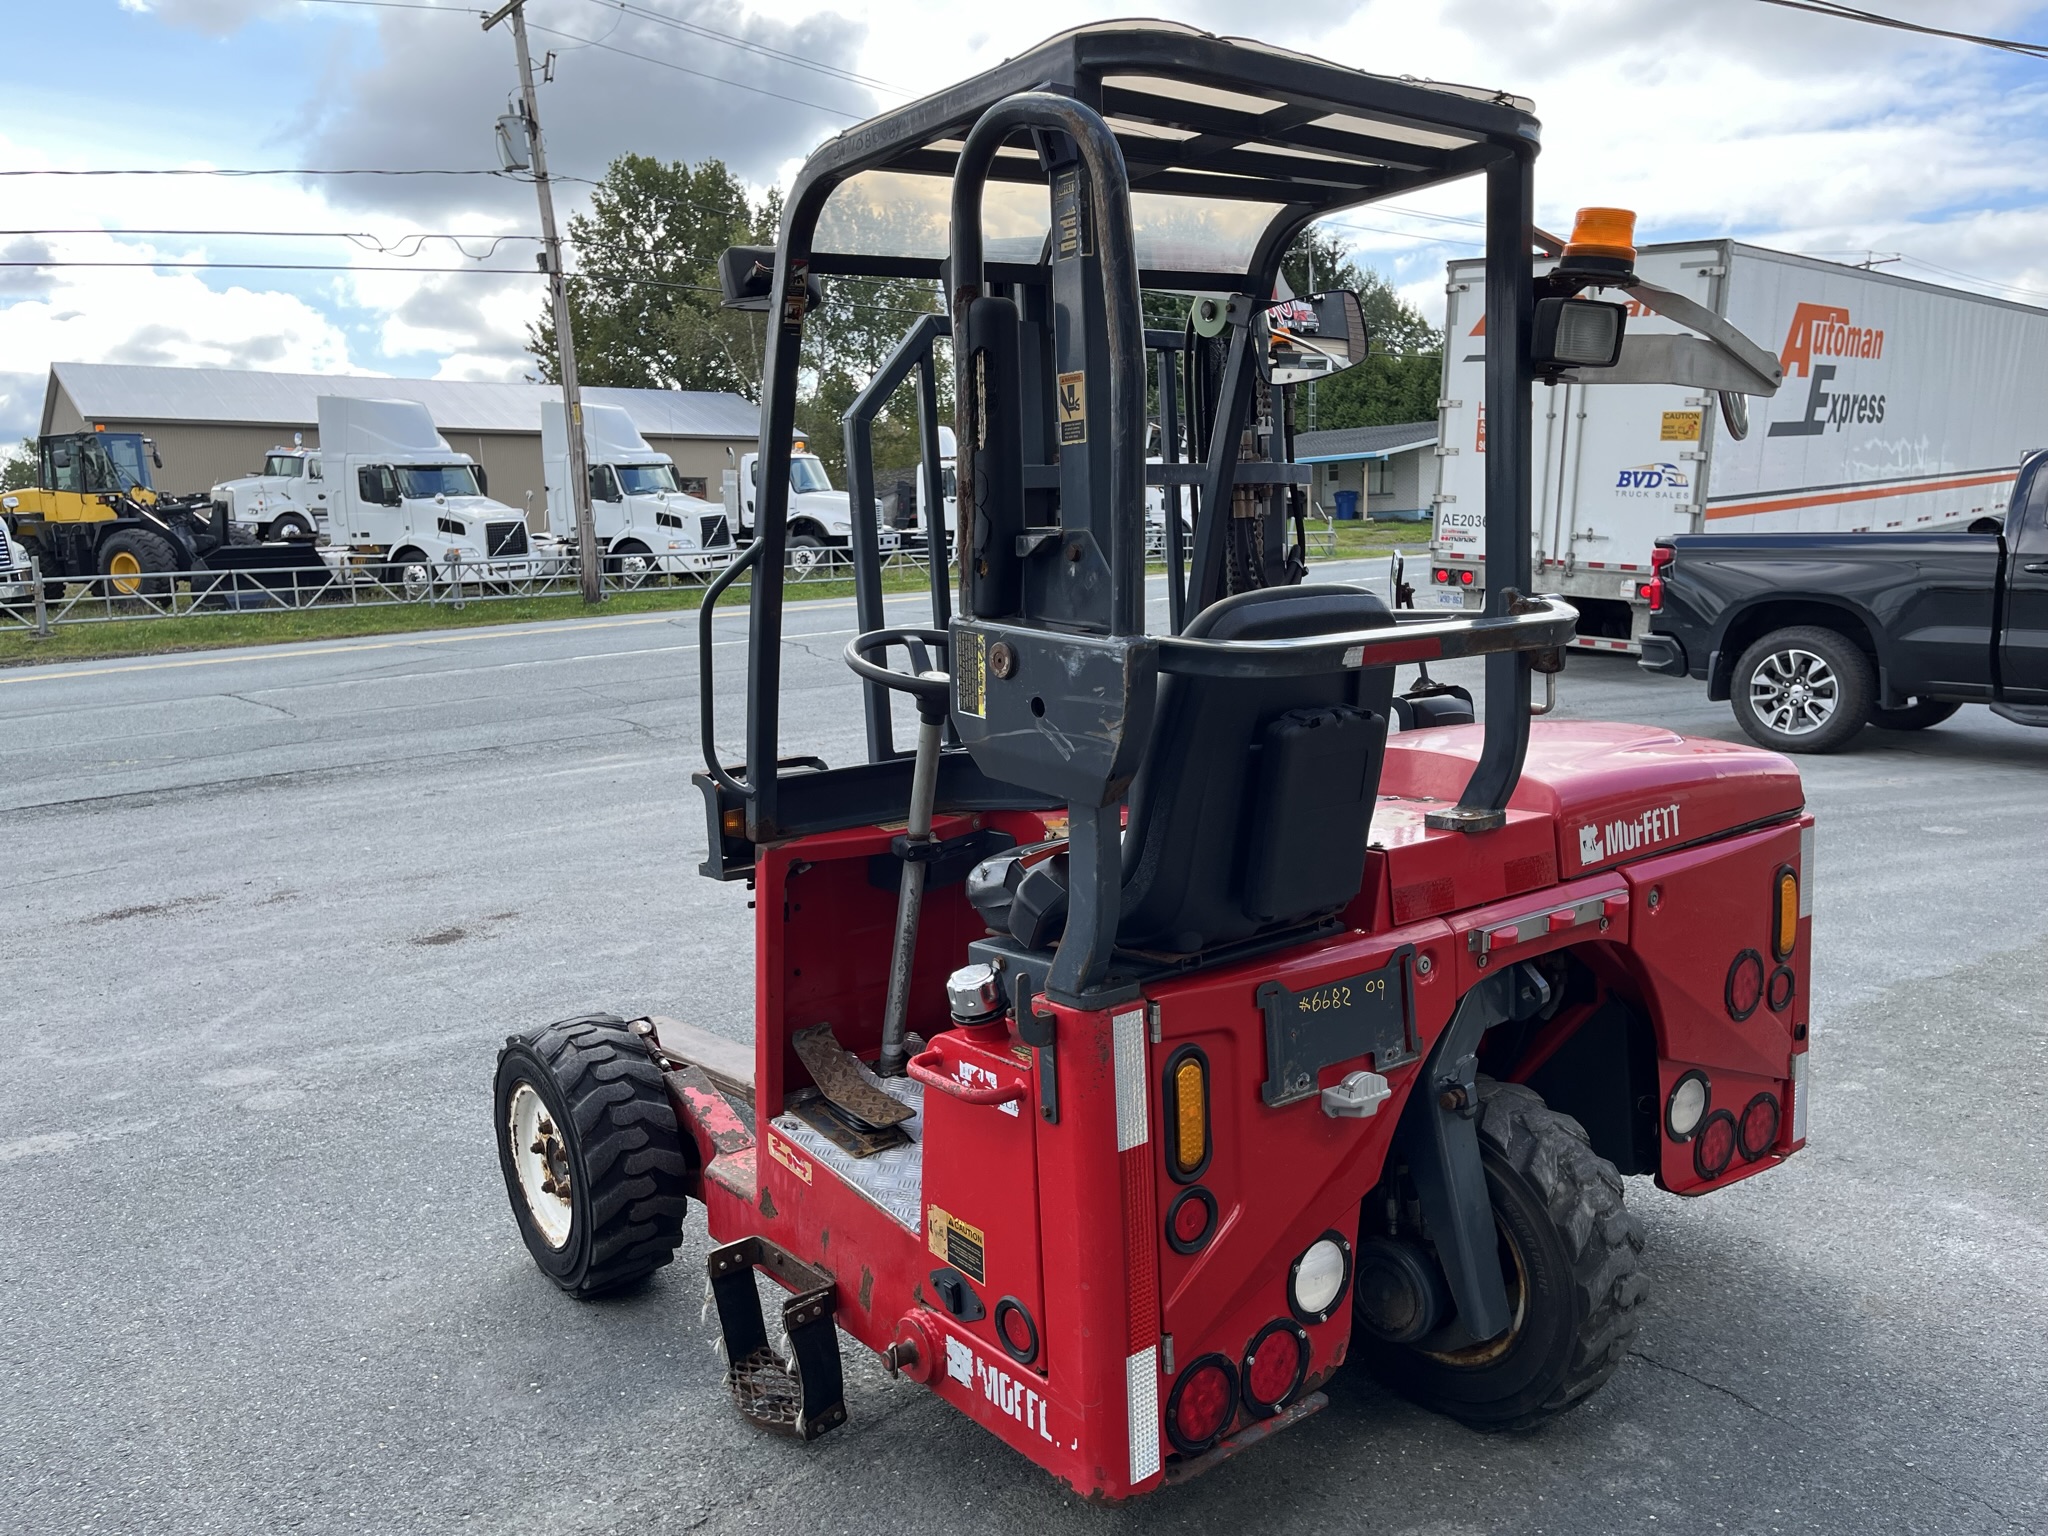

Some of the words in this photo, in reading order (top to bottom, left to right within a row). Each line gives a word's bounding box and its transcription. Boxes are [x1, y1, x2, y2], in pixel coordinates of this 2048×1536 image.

[1779, 302, 1884, 378] Automan
[1767, 364, 1886, 437] Express
[1663, 412, 1700, 420] CAUTION
[1616, 471, 1663, 488] BVD
[1615, 490, 1650, 498] TRUCK
[1655, 491, 1690, 500] SALES
[1299, 986, 1351, 1013] #6682
[1365, 979, 1385, 1001] 09
[954, 1220, 983, 1245] CAUTION
